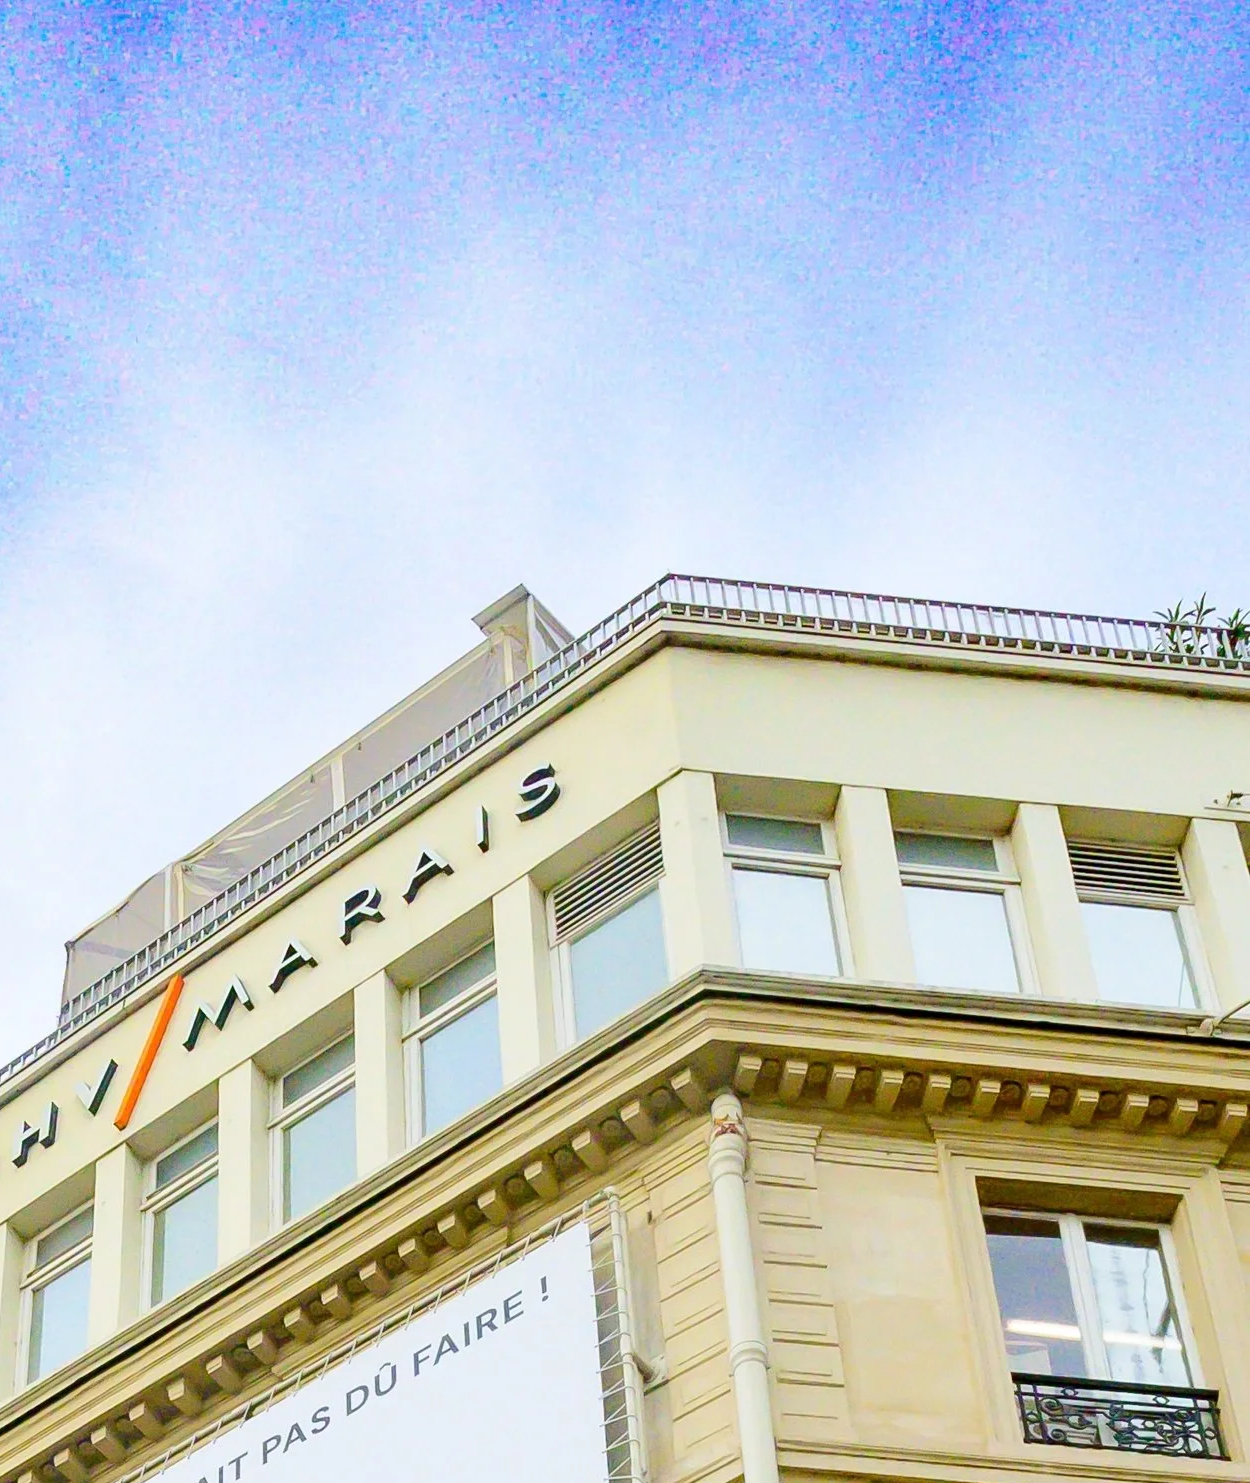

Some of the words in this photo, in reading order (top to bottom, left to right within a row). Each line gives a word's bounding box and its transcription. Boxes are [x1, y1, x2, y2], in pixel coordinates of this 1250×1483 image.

[261, 1405, 332, 1466] PAS
[345, 1361, 399, 1417] DÛ
[412, 1296, 527, 1380] FAIRE
